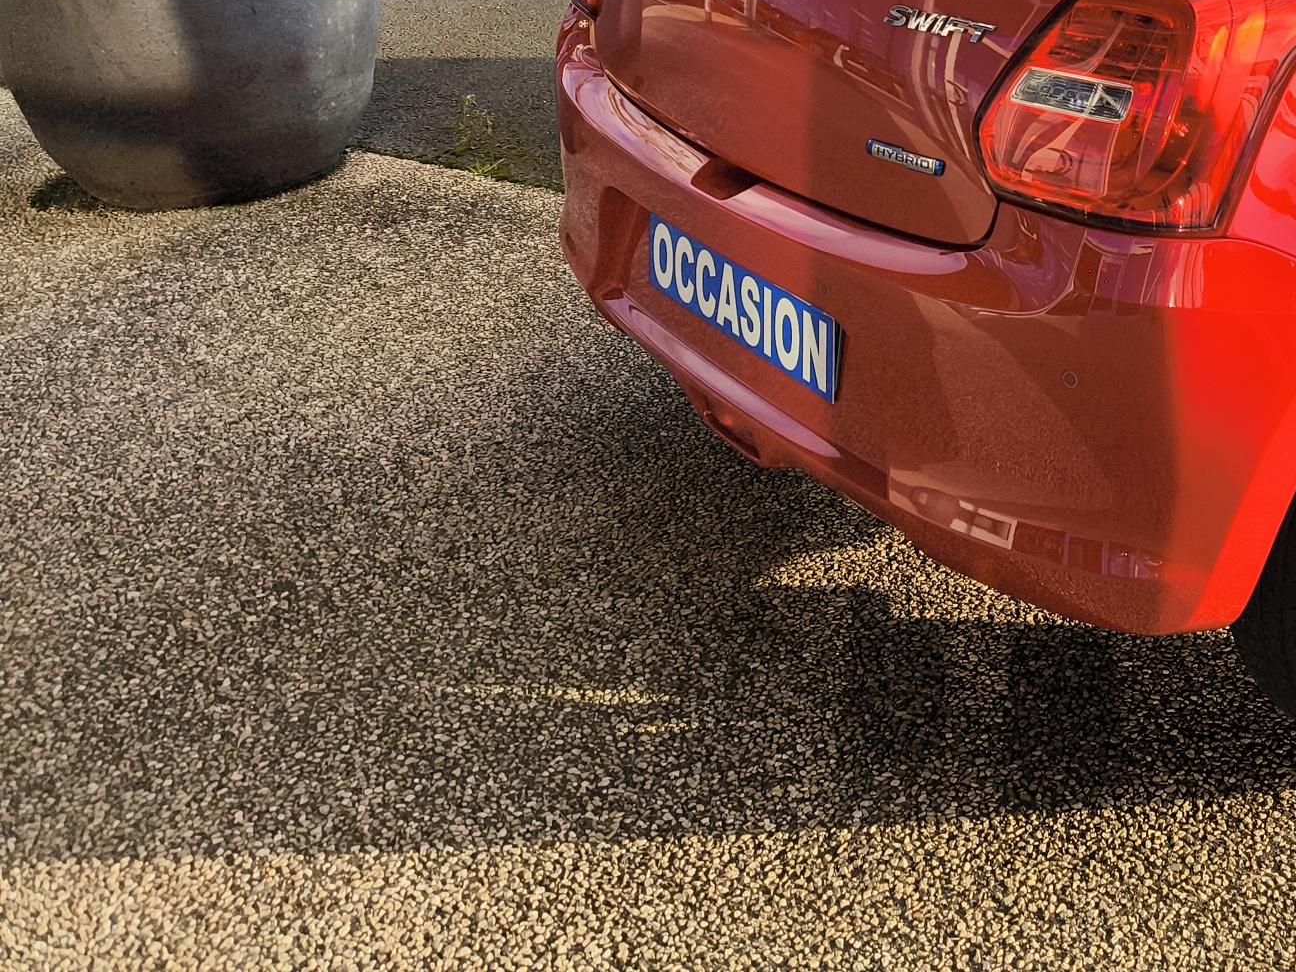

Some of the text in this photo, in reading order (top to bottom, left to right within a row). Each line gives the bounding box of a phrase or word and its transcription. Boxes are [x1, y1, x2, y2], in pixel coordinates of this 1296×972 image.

[883, 4, 997, 44] SWIFT
[876, 145, 930, 170] HYBRID
[653, 222, 828, 394] OCCASION
